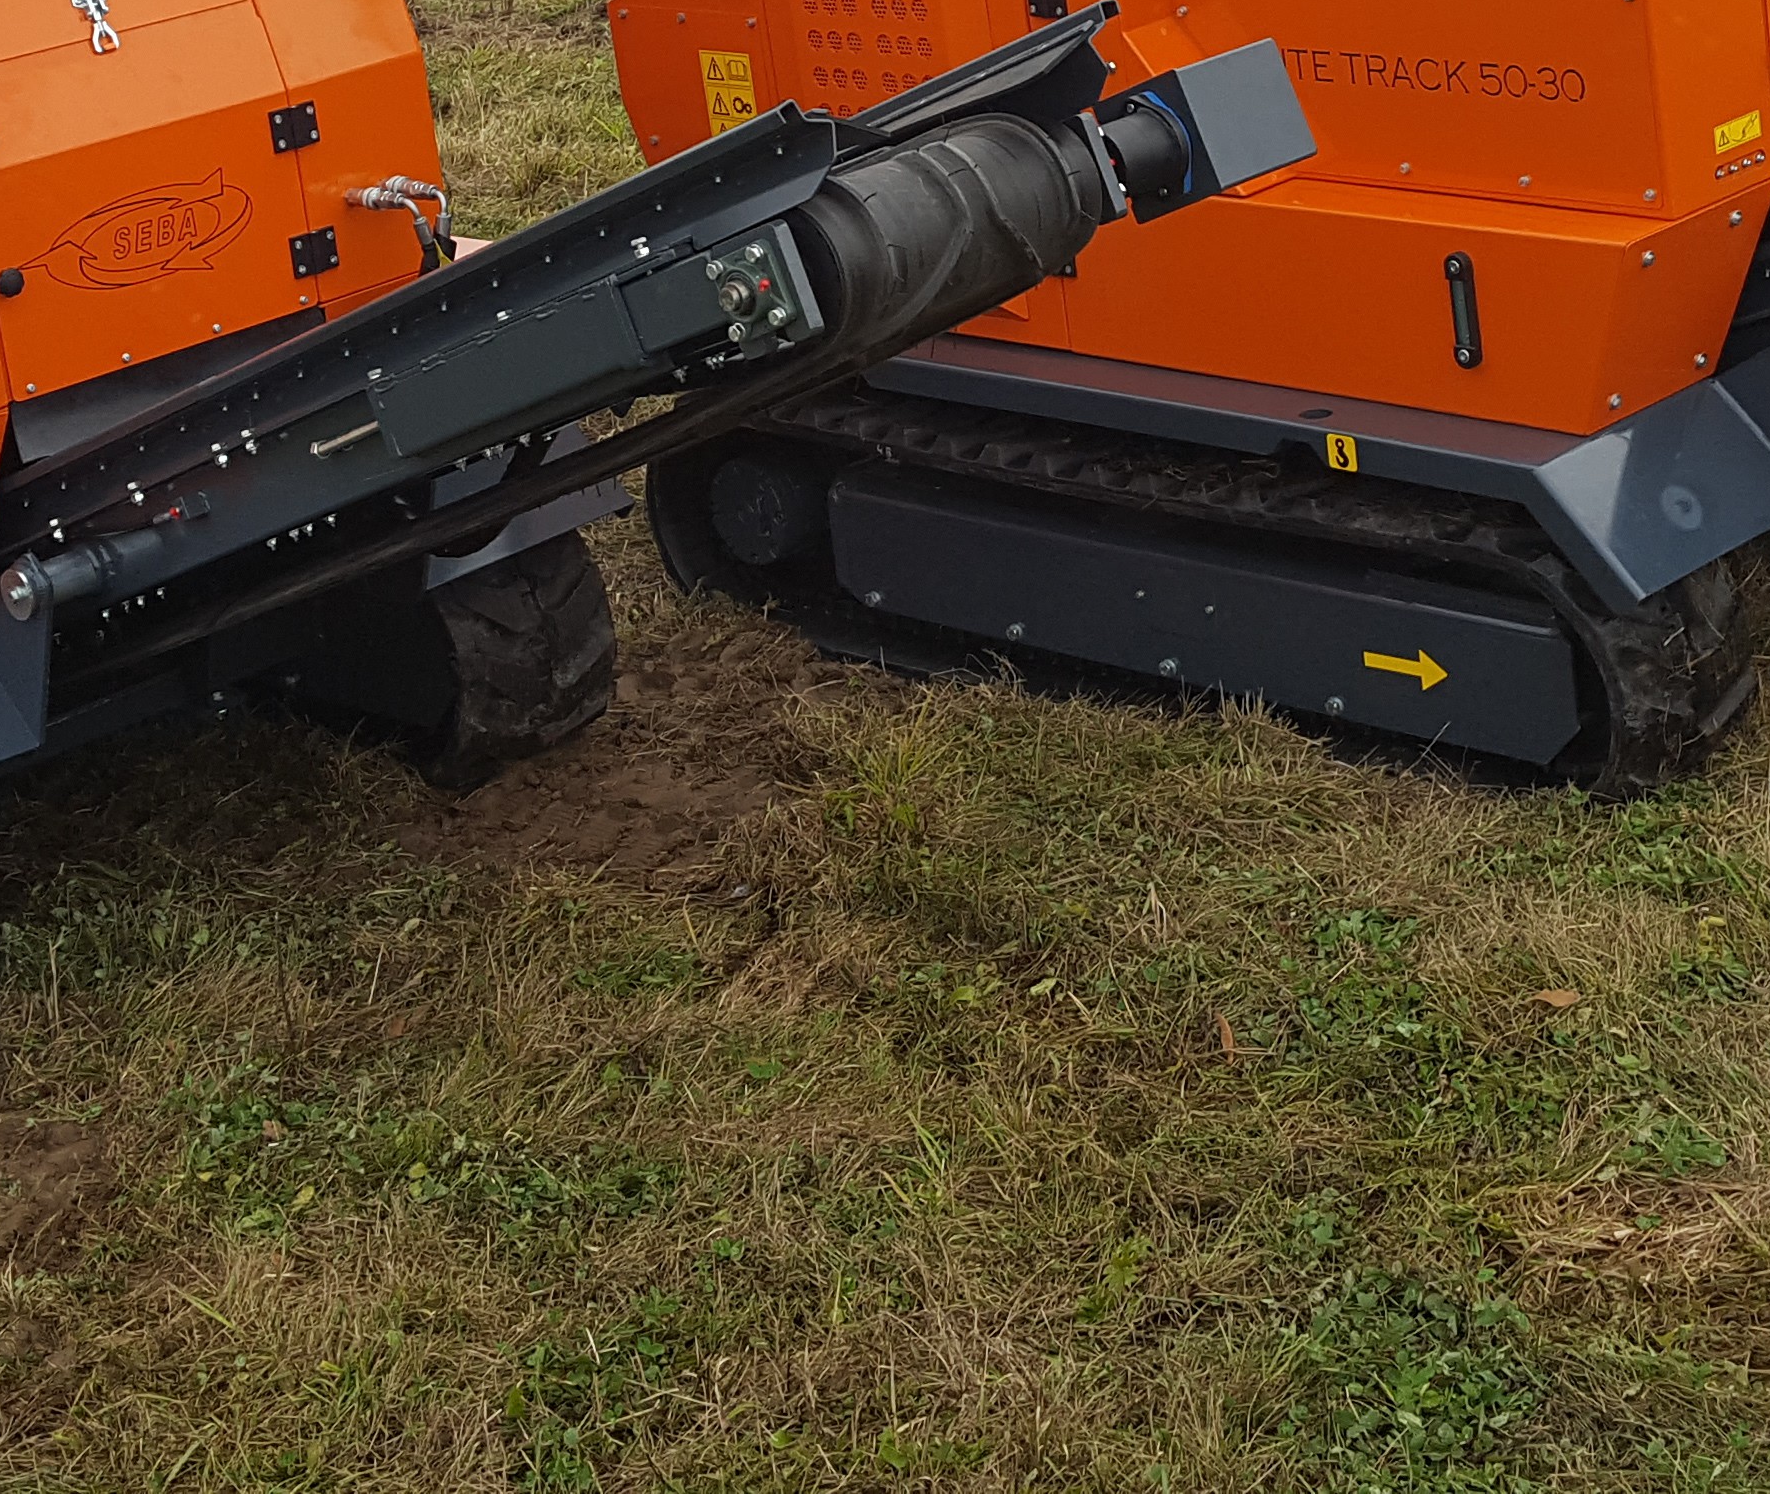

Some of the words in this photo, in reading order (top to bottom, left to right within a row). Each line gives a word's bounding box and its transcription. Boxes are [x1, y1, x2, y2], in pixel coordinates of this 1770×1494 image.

[1281, 48, 1334, 83] ITE
[1339, 52, 1470, 95] TRACK
[1479, 62, 1587, 103] 50-30
[113, 207, 198, 261] SEBA
